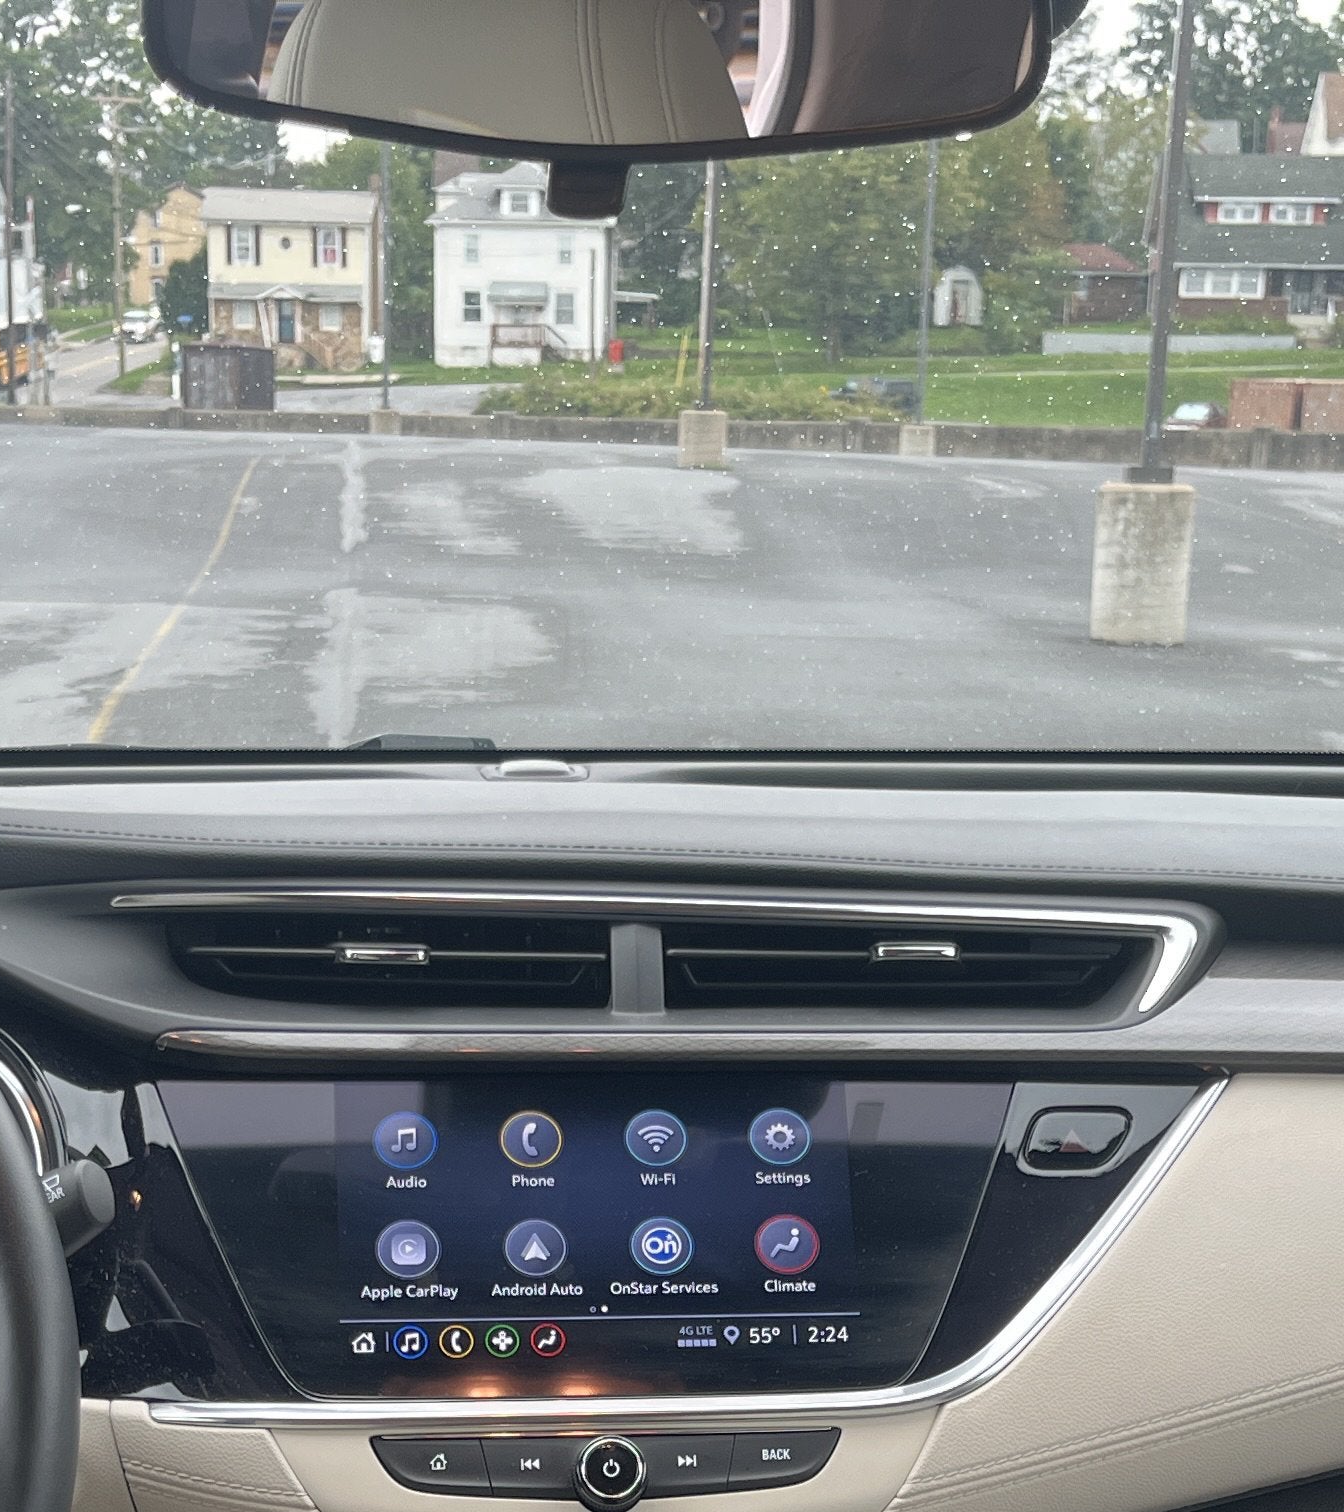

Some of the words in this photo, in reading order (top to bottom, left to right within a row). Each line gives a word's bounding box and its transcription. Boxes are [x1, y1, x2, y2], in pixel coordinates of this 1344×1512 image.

[387, 1175, 427, 1189] Audio
[511, 1174, 555, 1188] Phone
[640, 1172, 676, 1186] Wi-Fi
[755, 1170, 811, 1187] Settings
[361, 1284, 403, 1301] Apple
[408, 1283, 458, 1300] CarPlay
[492, 1283, 545, 1296] Android
[550, 1283, 583, 1295] Auto
[610, 1281, 657, 1295] OnStar
[661, 1281, 718, 1295] Services
[764, 1278, 816, 1293] Climate
[679, 1325, 694, 1336] 4G
[697, 1325, 713, 1336] LTE
[808, 1325, 849, 1344] 2:24
[762, 1448, 791, 1461] BACK
